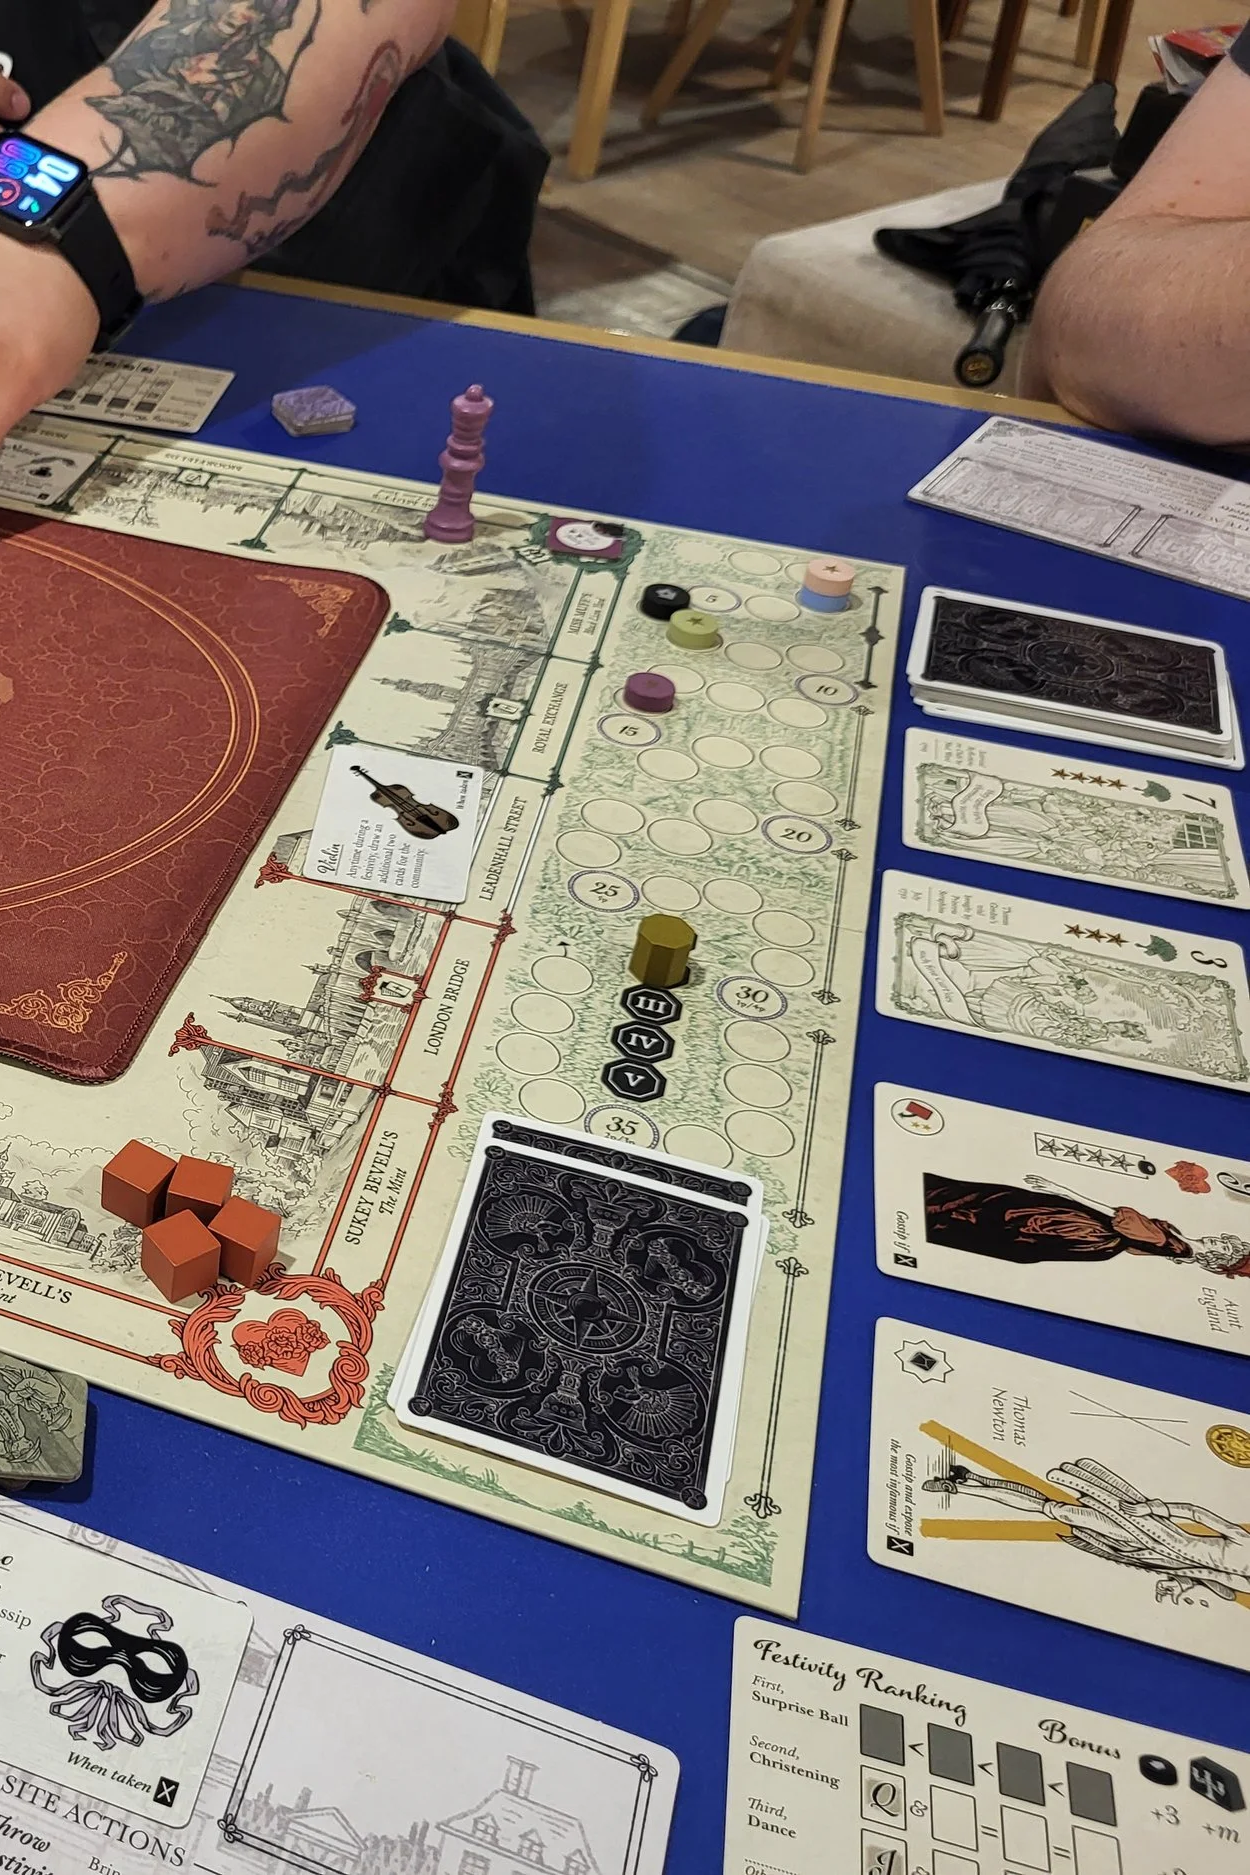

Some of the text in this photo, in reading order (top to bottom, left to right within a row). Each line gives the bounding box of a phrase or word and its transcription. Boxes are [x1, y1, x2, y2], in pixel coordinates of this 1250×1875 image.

[23, 154, 80, 198] 04
[815, 684, 837, 697] 10
[532, 682, 568, 755] ROYAL EXCHANGE
[618, 725, 638, 737] 15
[479, 796, 527, 902] LEADENHALL STREET
[778, 827, 813, 844] 20
[317, 843, 341, 875] Violin
[379, 847, 394, 884] additional
[589, 881, 621, 898] 25
[424, 958, 470, 1055] LONDON BRIDGE
[634, 996, 668, 1014] III
[735, 984, 770, 1004] 30
[626, 1032, 659, 1049] IV
[623, 1071, 647, 1087] V
[605, 1116, 640, 1136] 35
[344, 1129, 399, 1246] SUKEY BEVELL'S
[378, 1168, 408, 1216] The Mint
[893, 1210, 911, 1240] Gossip
[1197, 1286, 1230, 1334] England
[1223, 1297, 1244, 1331] Aunt
[992, 1386, 1008, 1442] Newton
[1013, 1396, 1032, 1448] Thomas
[886, 1478, 899, 1524] infamous
[901, 1453, 917, 1537] Gossip expose
[751, 1675, 786, 1695] First,
[752, 1638, 968, 1727] Festivity Ranking
[751, 1689, 850, 1728] Surprise Ball
[749, 1734, 801, 1761] Second,
[1037, 1717, 1122, 1760] Bonus
[66, 1750, 152, 1795] When taken
[749, 1751, 842, 1790] Christening
[0, 1774, 187, 1868] SITE ACTIONS
[746, 1796, 789, 1820] Third,
[747, 1814, 798, 1839] Dance
[1151, 1804, 1181, 1827] +3
